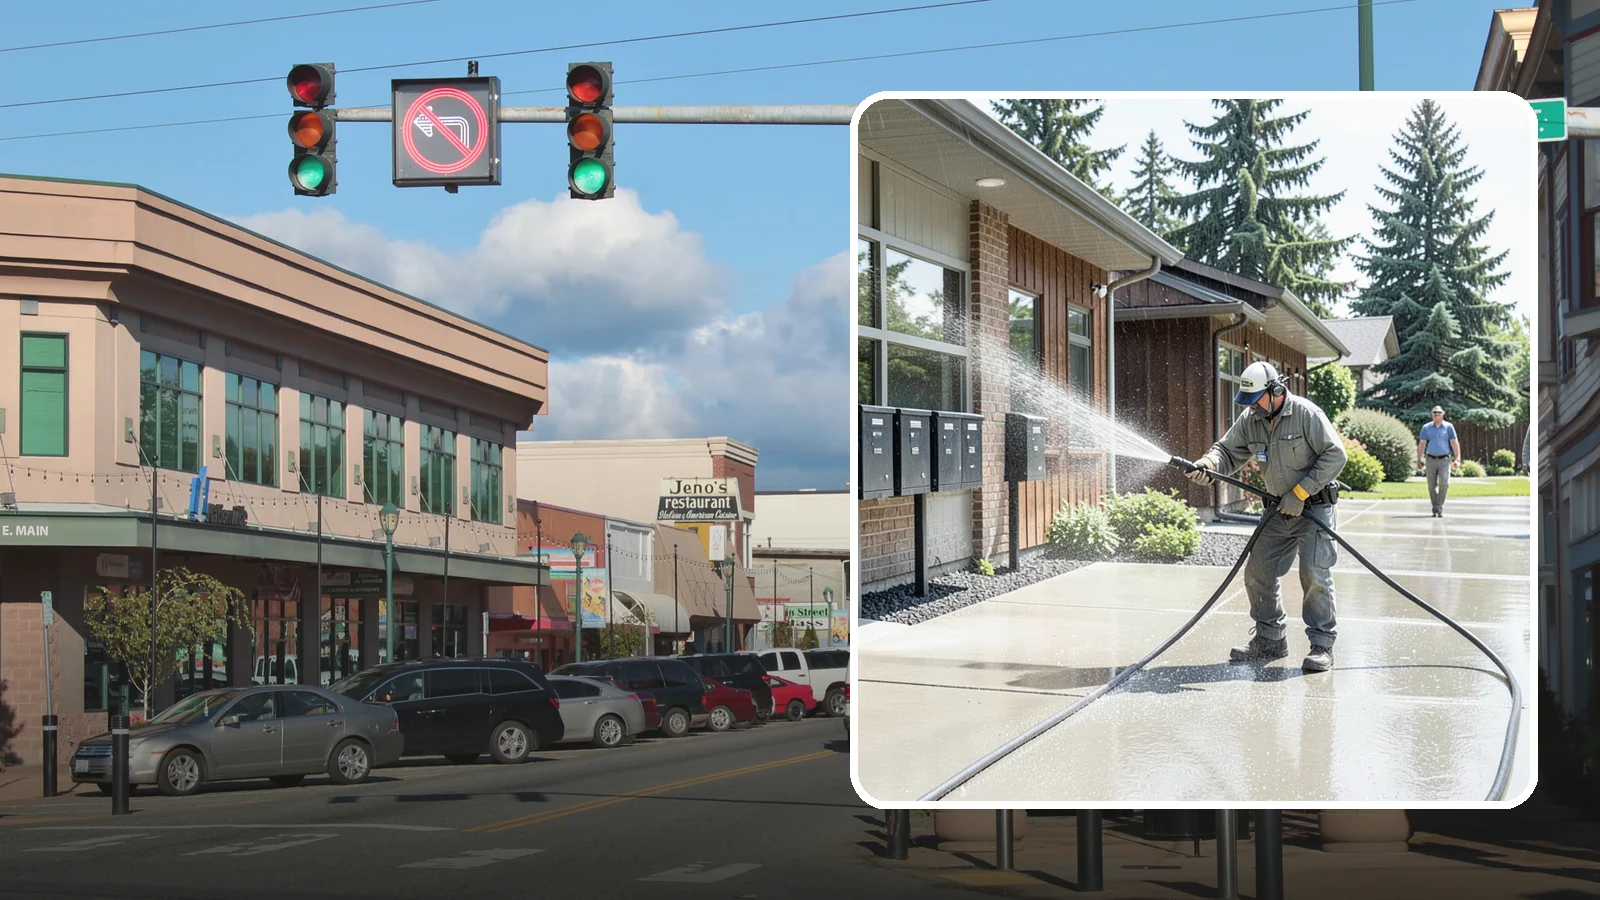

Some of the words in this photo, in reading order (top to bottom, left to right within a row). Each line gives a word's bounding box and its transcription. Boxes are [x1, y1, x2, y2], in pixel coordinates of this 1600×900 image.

[670, 480, 727, 494] Jeno's
[666, 497, 730, 508] restaurant
[659, 510, 681, 519] Italian
[686, 509, 714, 519] American
[715, 509, 737, 519] Cuisine
[2, 525, 13, 536] E.
[15, 525, 49, 536] MAIN
[797, 607, 829, 617] Street
